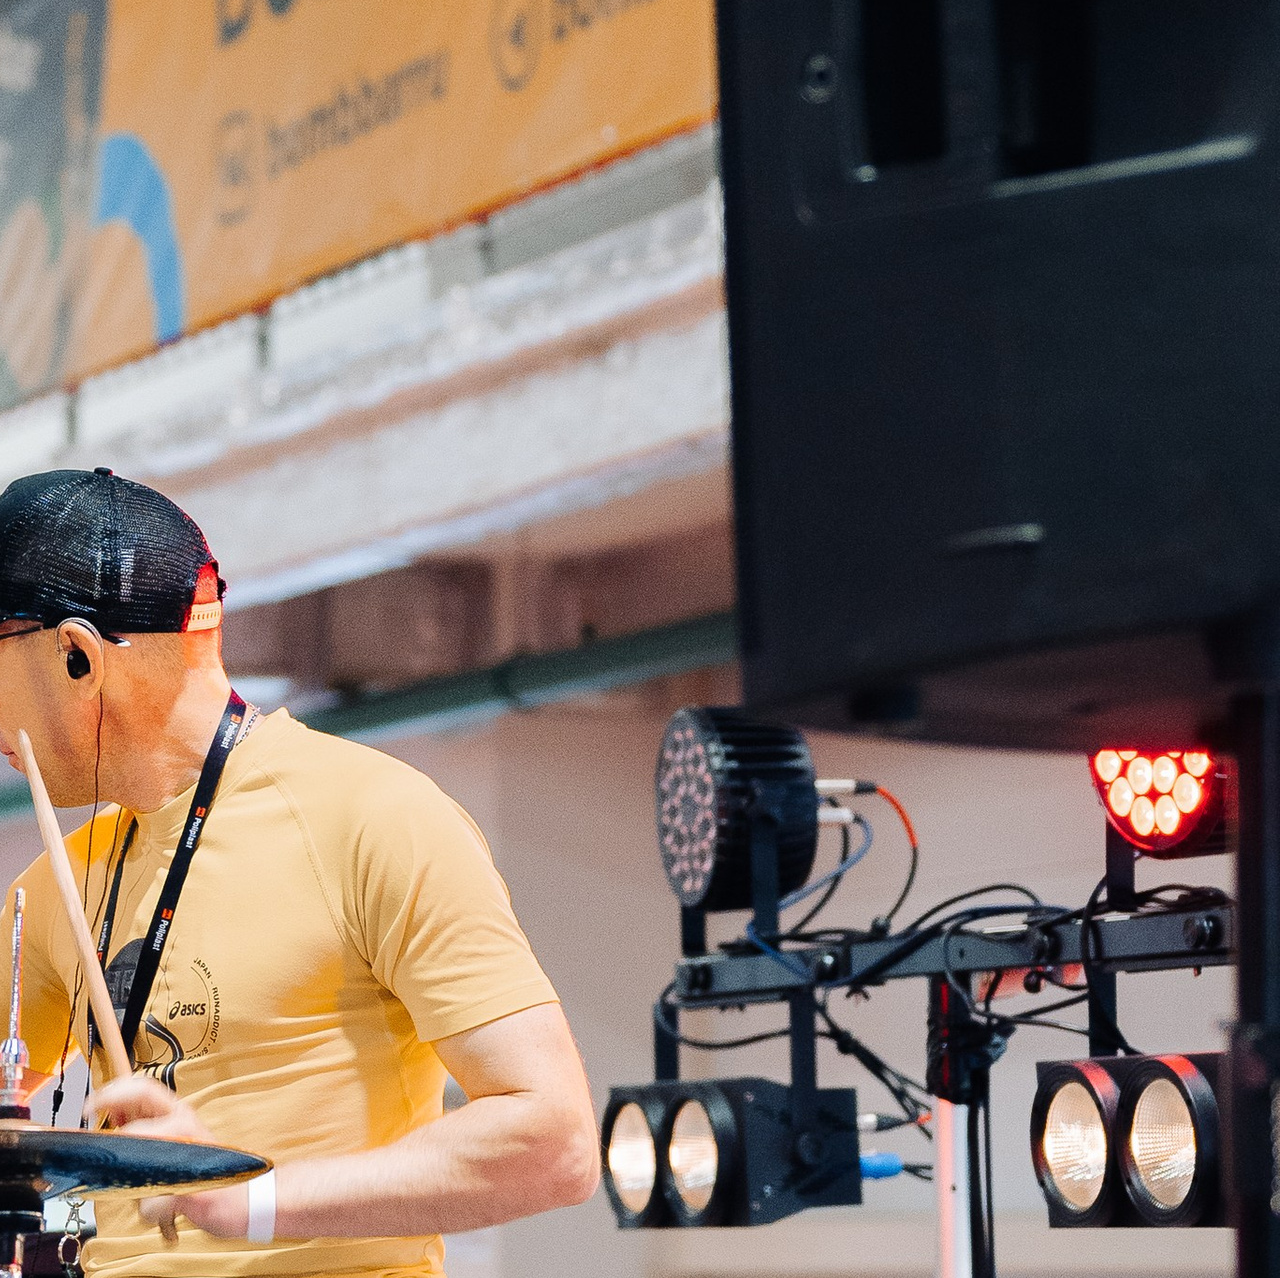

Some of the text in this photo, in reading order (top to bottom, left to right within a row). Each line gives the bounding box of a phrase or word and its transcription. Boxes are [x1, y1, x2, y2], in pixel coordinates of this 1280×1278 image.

[185, 817, 202, 849] Poliplast
[152, 919, 169, 951] Poliplast
[193, 957, 212, 979] JAPAN
[210, 986, 220, 1043] RUNADDICT
